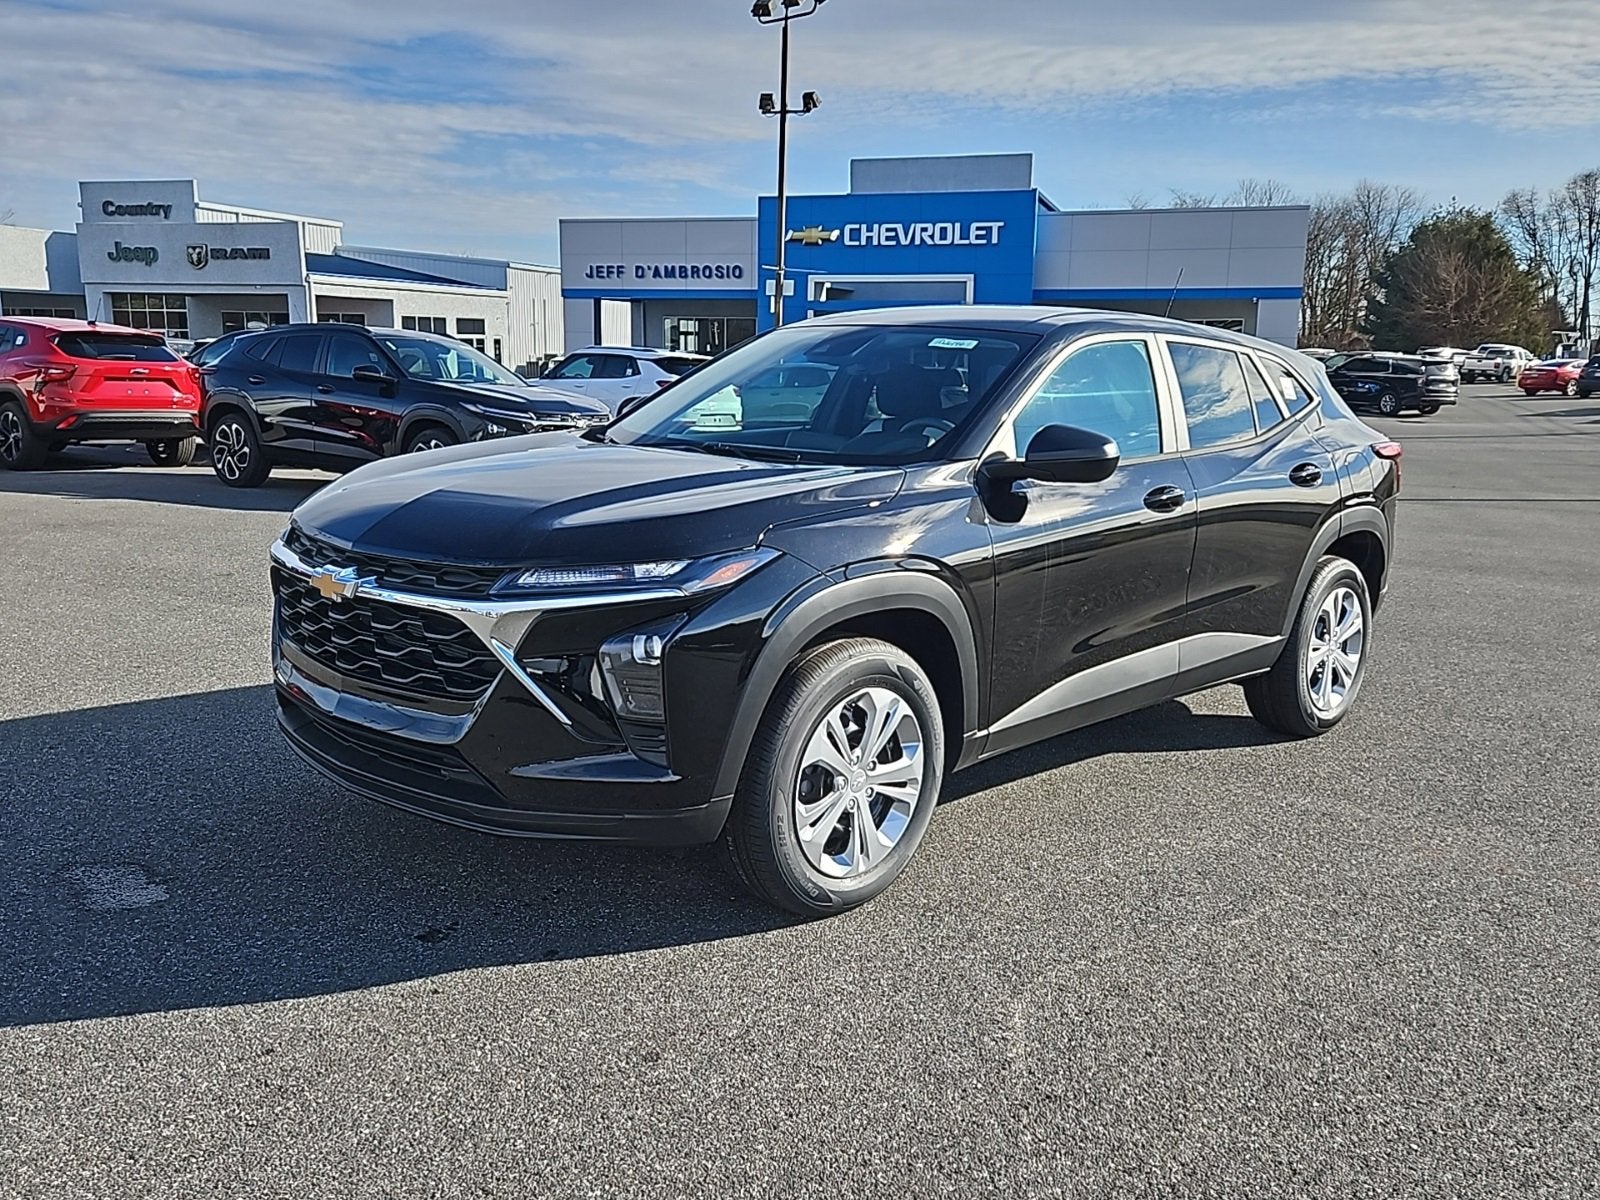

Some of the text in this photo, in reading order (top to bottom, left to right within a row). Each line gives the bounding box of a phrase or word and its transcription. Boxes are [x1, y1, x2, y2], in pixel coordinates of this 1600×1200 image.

[102, 200, 172, 219] Country
[843, 221, 1005, 247] CHEVROLET
[107, 241, 159, 266] Jeep
[210, 247, 270, 260] RAM
[585, 264, 743, 279] JEFF D'AMBROSIO
